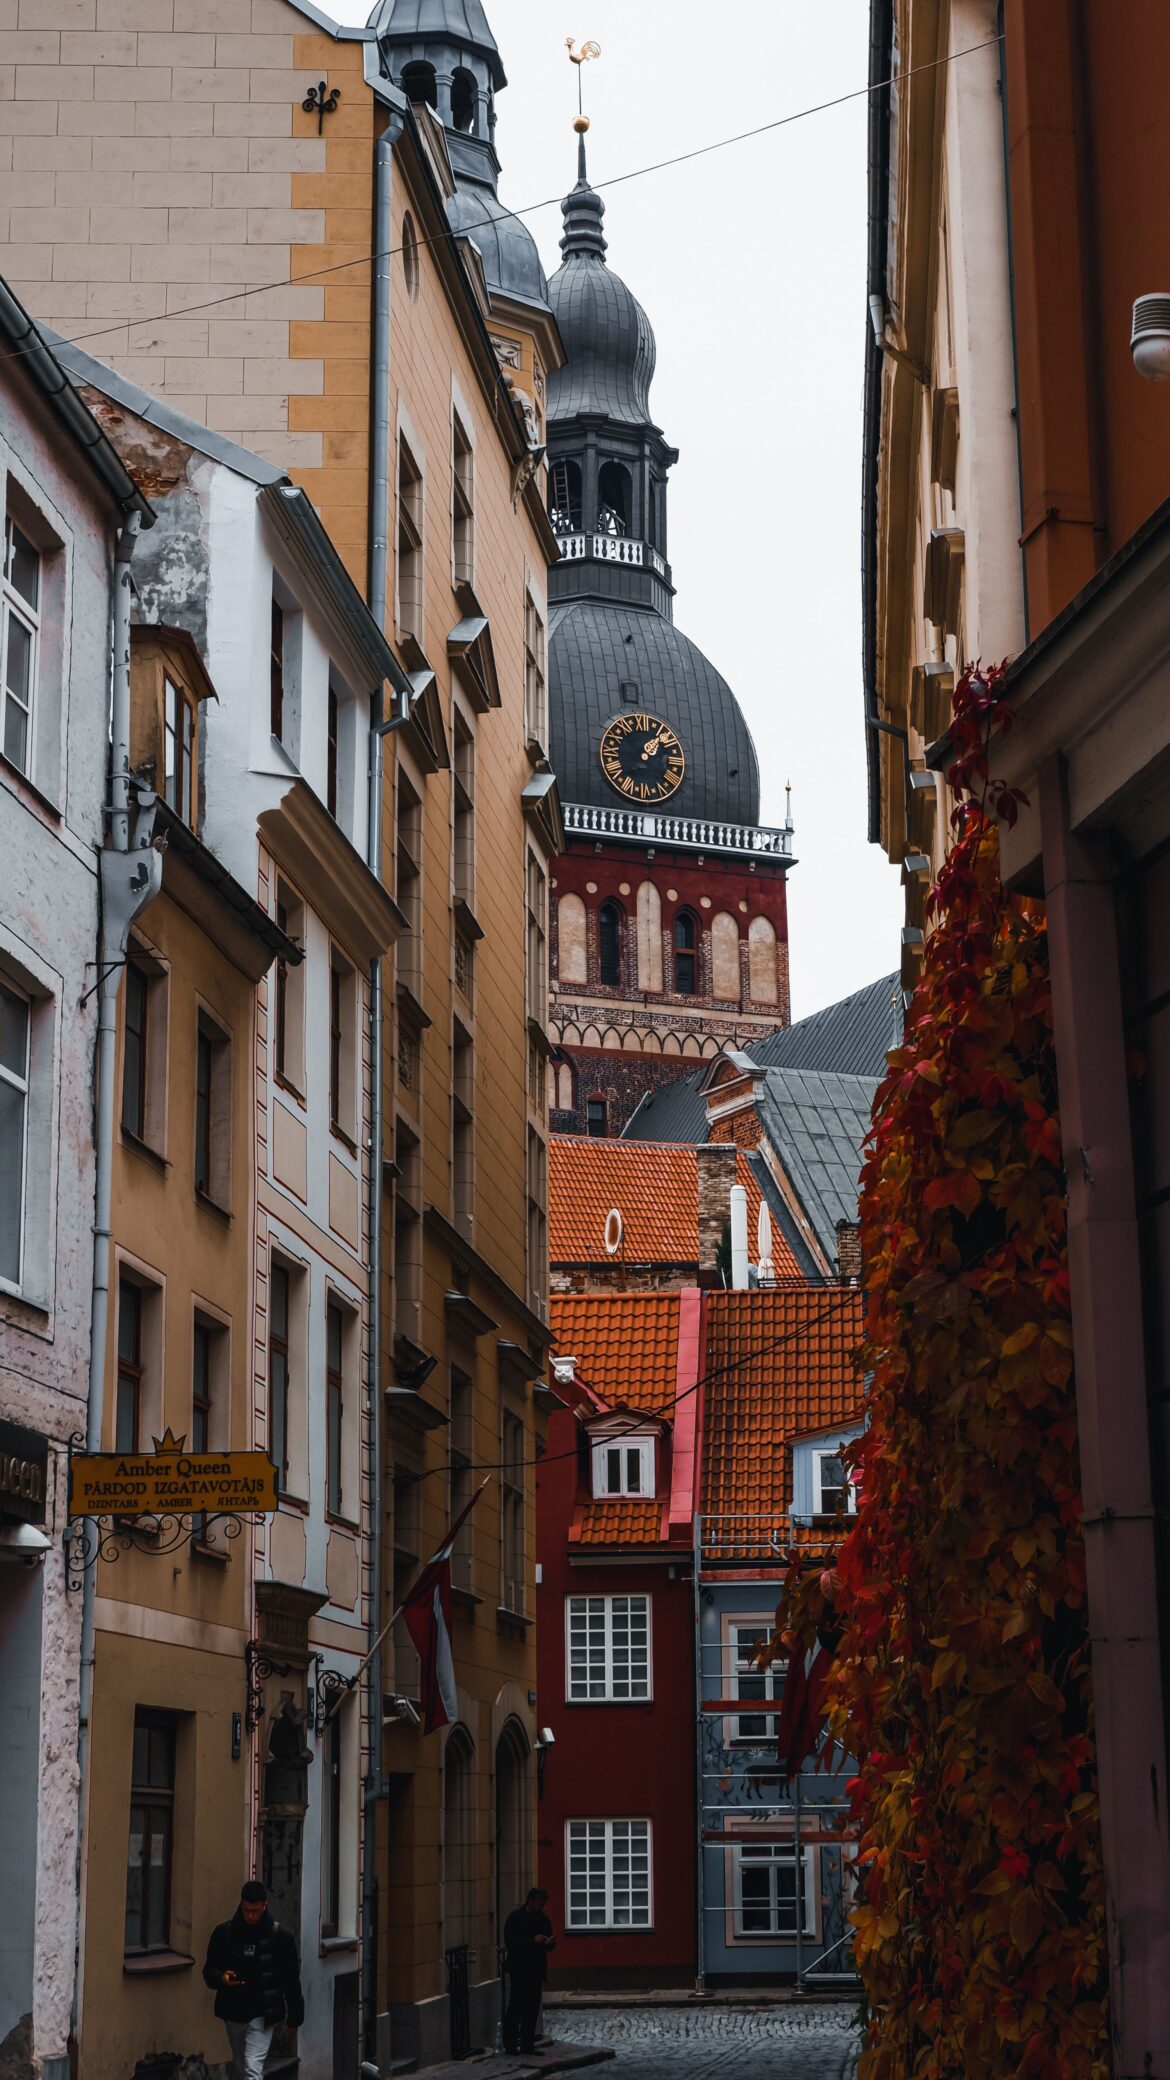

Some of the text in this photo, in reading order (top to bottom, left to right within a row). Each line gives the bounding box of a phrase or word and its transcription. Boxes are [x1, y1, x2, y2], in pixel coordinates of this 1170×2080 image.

[635, 715, 649, 732] XII
[606, 730, 624, 745] X
[114, 1458, 232, 1477] Amber Queen
[84, 1477, 265, 1496] PĀRDOD IZGATAVOTĀJS
[88, 1496, 260, 1509] DZINTARS AMBER ЯНТАРЬ
